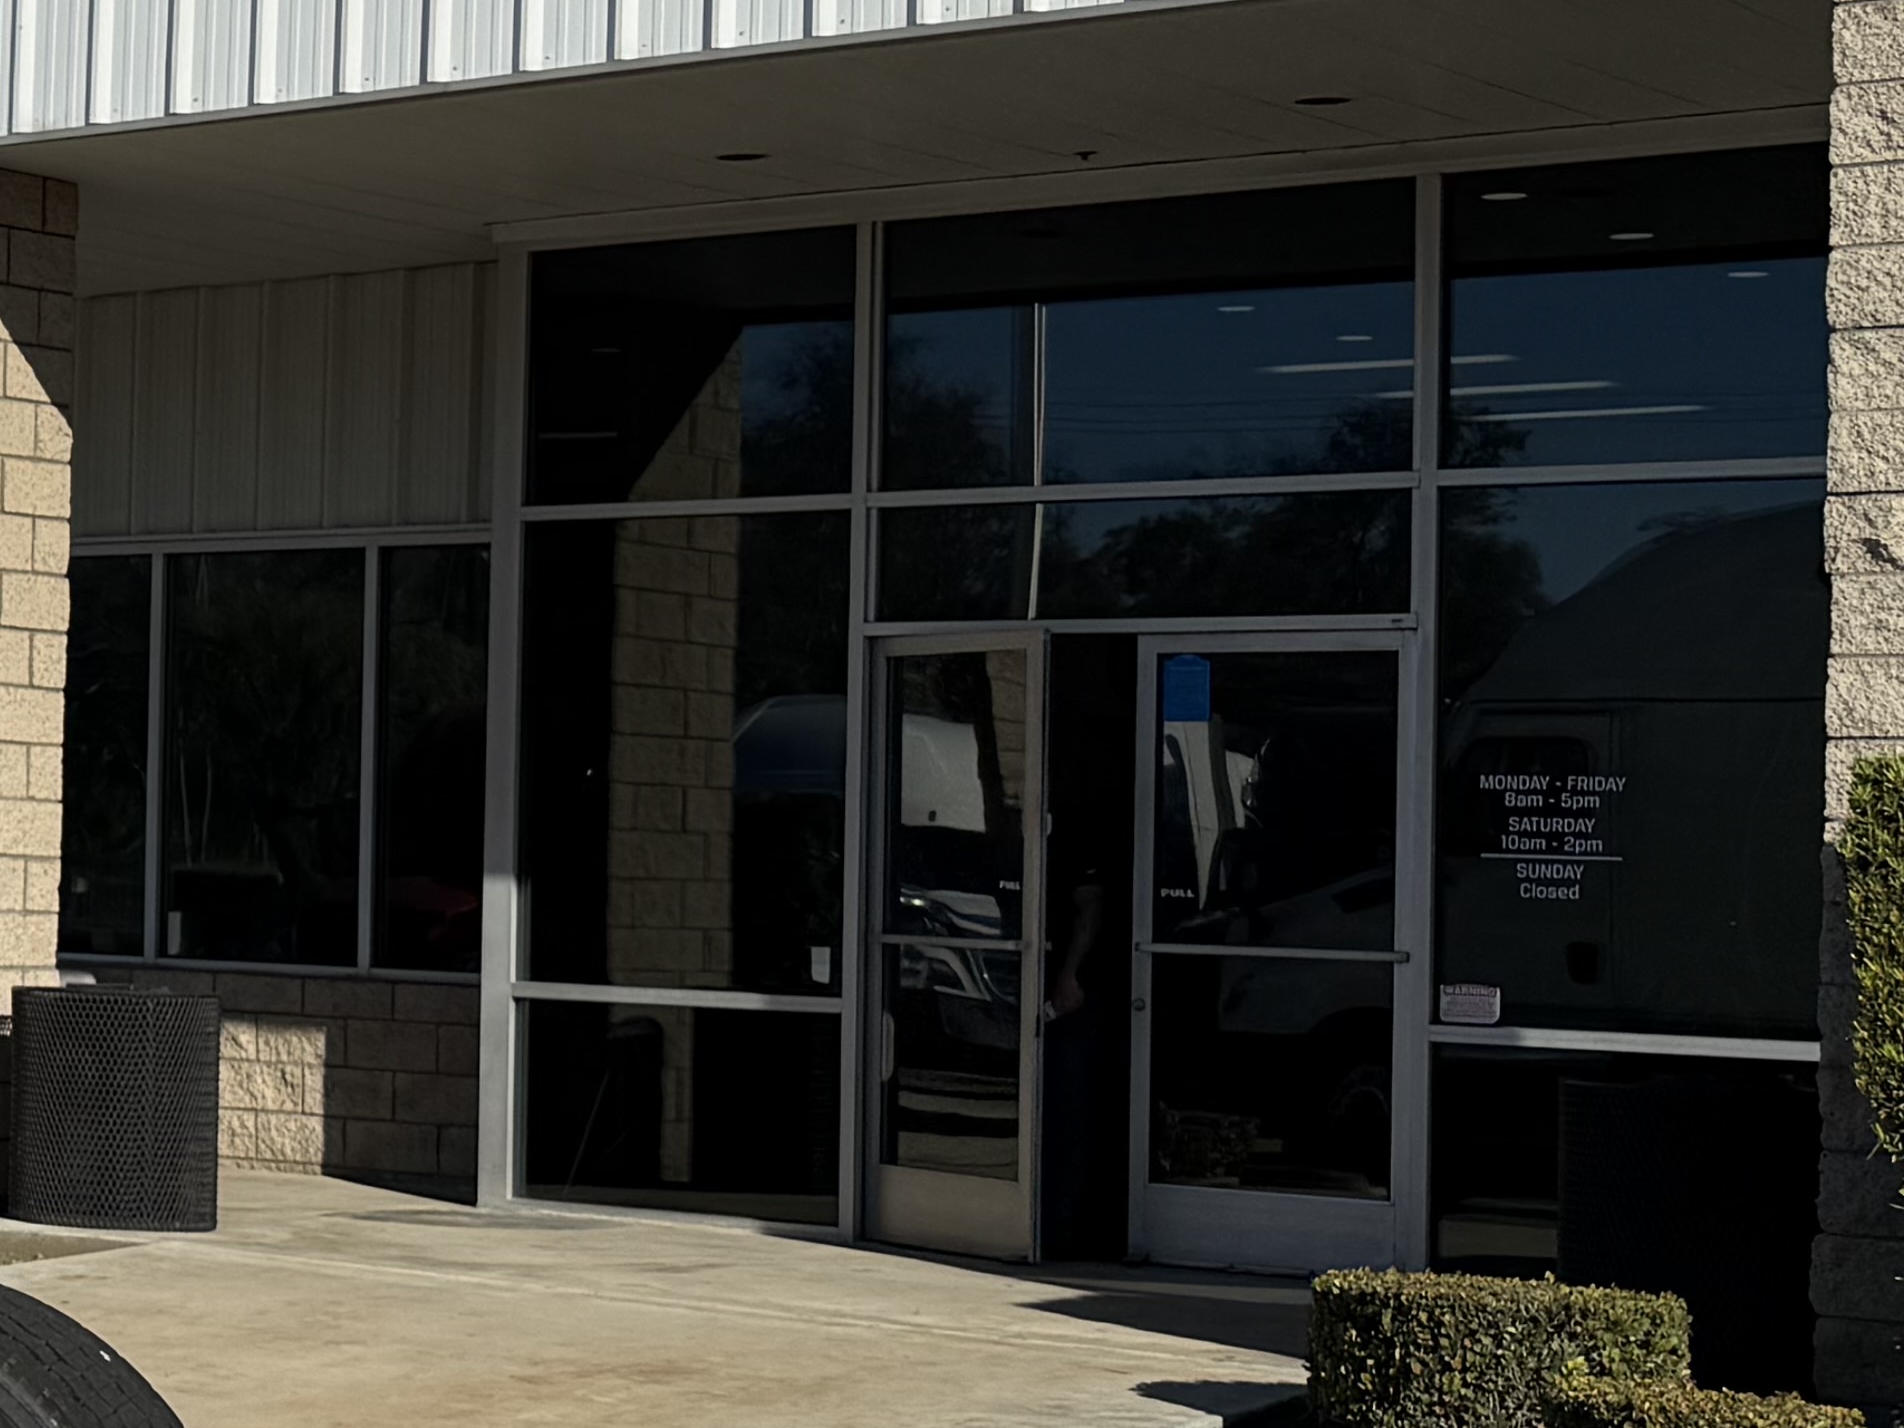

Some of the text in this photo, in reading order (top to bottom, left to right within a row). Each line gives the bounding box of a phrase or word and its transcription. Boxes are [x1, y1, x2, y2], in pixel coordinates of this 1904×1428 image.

[1479, 774, 1550, 790] MONDAY
[1567, 775, 1626, 792] FRIDAY
[1504, 791, 1543, 807] 8am
[1561, 792, 1600, 810] 5pm
[1508, 816, 1595, 833] SATURDAY
[1501, 834, 1546, 850] 10am
[1563, 836, 1603, 854] 2pm
[1516, 862, 1584, 880] SUNDAY
[1160, 888, 1195, 898] PULL
[1520, 883, 1580, 899] Closed
